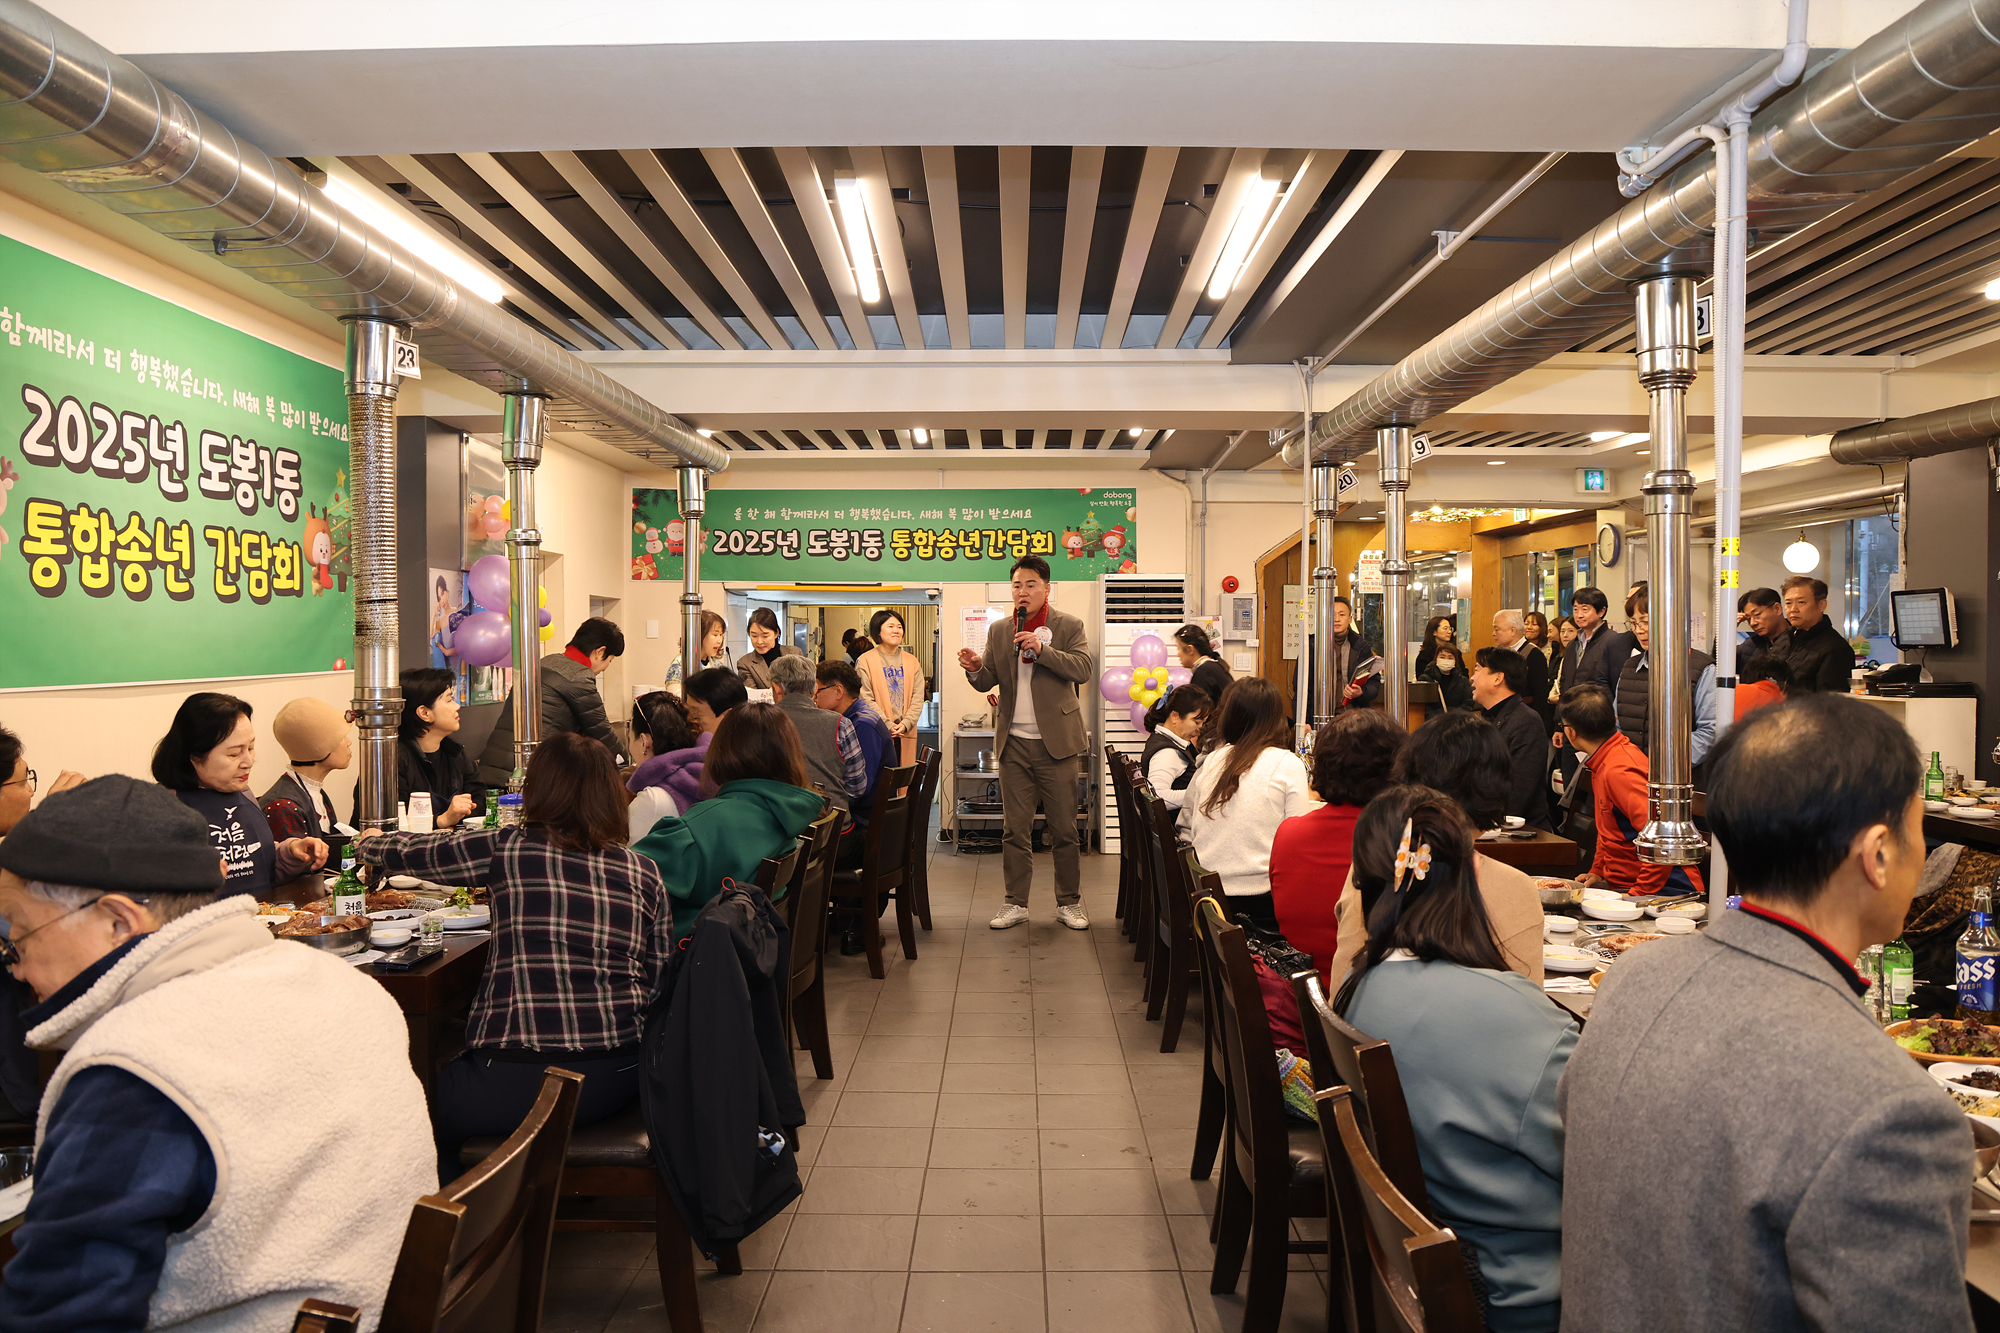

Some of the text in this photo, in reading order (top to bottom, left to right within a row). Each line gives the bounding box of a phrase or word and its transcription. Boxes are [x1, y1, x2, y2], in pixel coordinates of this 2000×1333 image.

[397, 346, 415, 369] 23
[0, 306, 349, 442] 함께라서 더 행복했습니다. 새해 복 많이 받으세요
[20, 384, 302, 521] 2025년 도봉1동
[1338, 474, 1353, 490] 20
[1103, 491, 1132, 499] dobong
[733, 507, 1033, 521] 올 한 해 함께라서 더 행복했습니다. 새해 복 많이 받으세요
[20, 497, 303, 604] 통합송년 간담회
[712, 527, 1056, 561] 2025년 도봉1동 통합송년간담회
[208, 821, 245, 843] 처음
[214, 844, 251, 862] 처럼
[344, 900, 363, 911] 처음
[1960, 982, 1982, 991] FRESH
